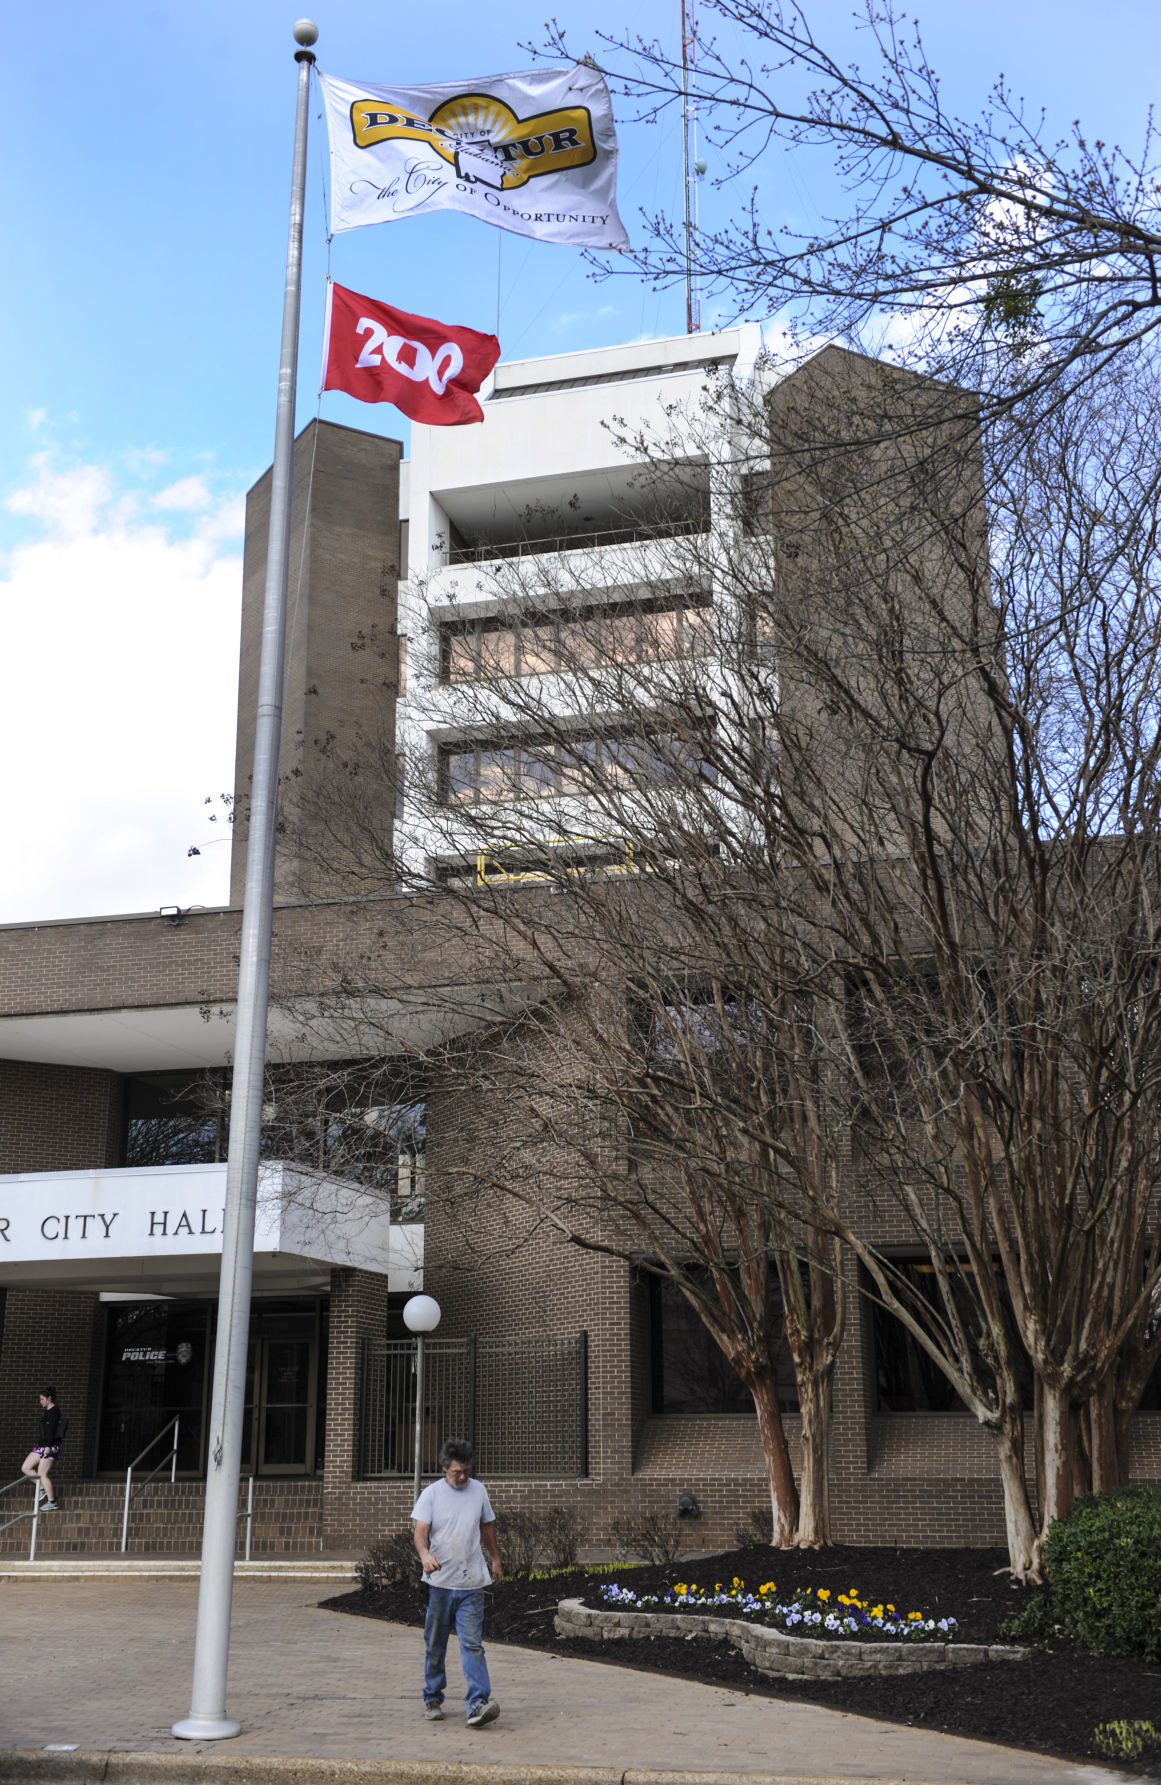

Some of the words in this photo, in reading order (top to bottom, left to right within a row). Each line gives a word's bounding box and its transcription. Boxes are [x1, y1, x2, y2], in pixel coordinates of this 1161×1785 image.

[361, 112, 584, 162] DECTUR
[480, 129, 492, 137] OF
[393, 157, 449, 213] City
[455, 183, 478, 195] OF
[484, 192, 610, 225] OPPORTUNITY
[355, 317, 464, 396] 200
[40, 1212, 120, 1240] CITY
[121, 1351, 167, 1361] POLICE
